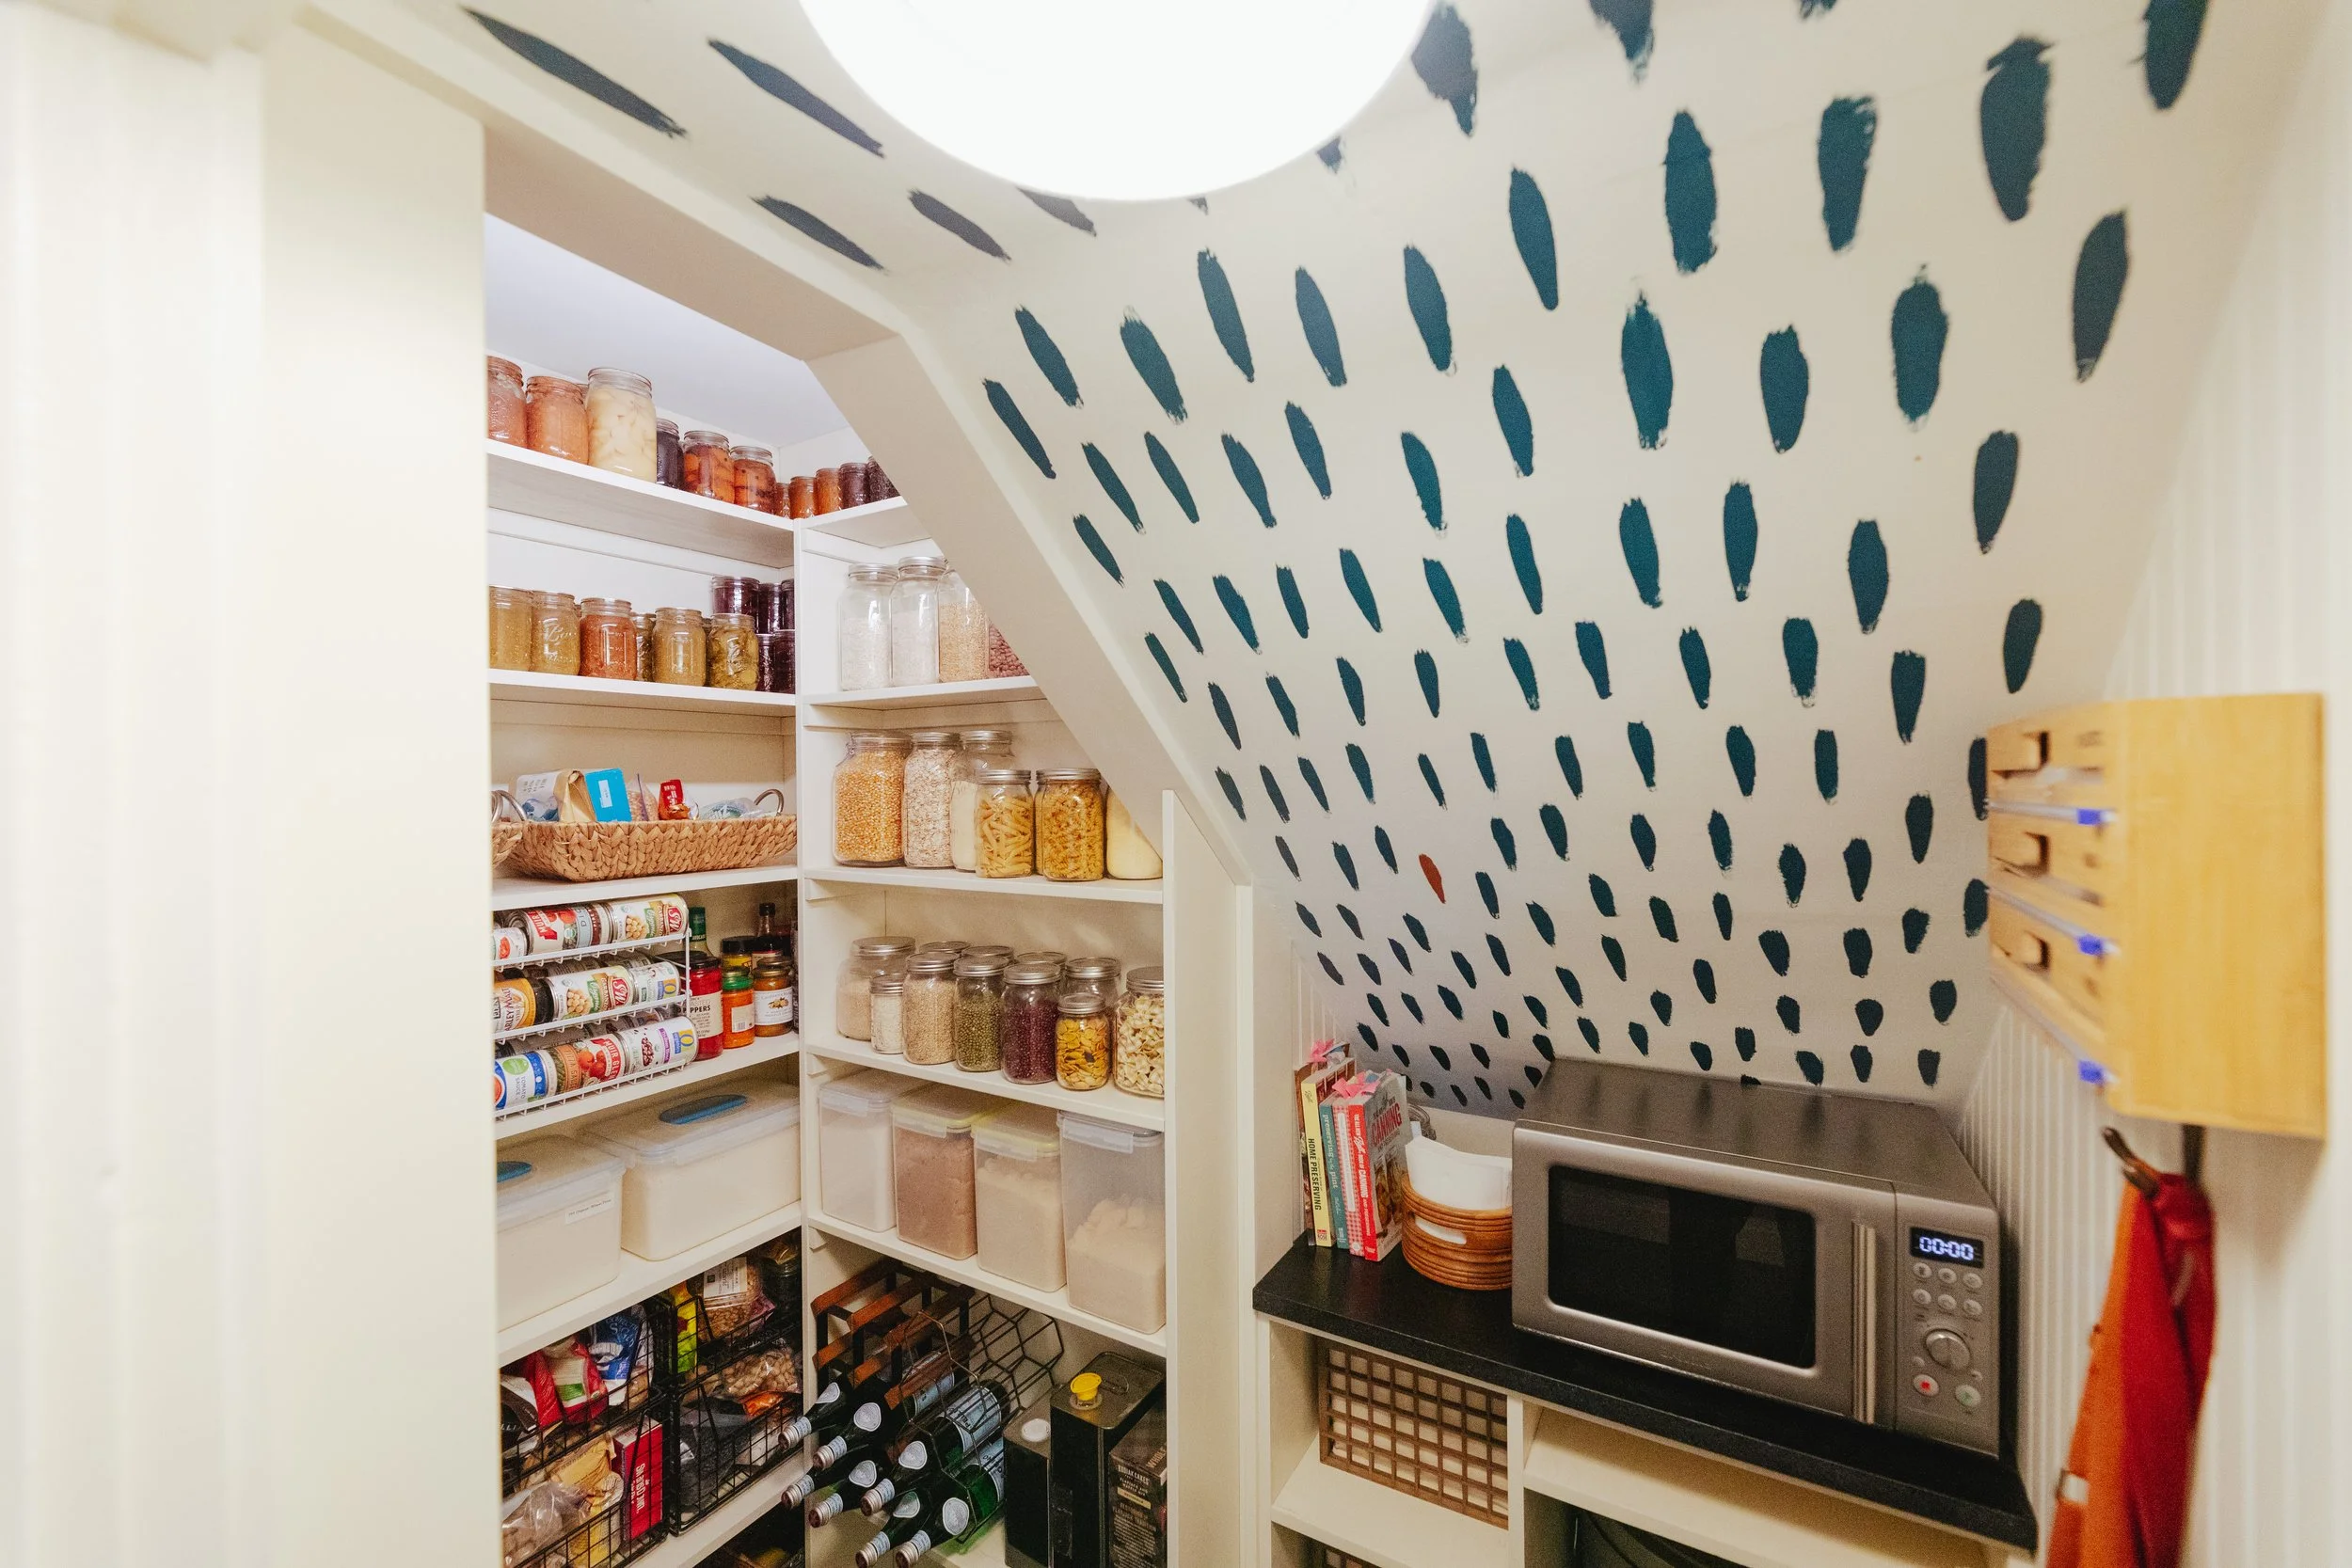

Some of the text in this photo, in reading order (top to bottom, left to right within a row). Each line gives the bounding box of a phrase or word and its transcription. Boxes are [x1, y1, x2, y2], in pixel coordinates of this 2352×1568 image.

[504, 1005, 515, 1031] ARLEY
[682, 1005, 711, 1013] PPPERS
[603, 1038, 616, 1058] MUIR
[1372, 1102, 1402, 1148] CANNING
[1322, 1114, 1334, 1158] preserving
[1329, 1171, 1339, 1189] pint
[1308, 1138, 1322, 1211] HOME PRESERVING
[1359, 1169, 1369, 1198] CANNING
[1919, 1236, 1974, 1260] 00:00
